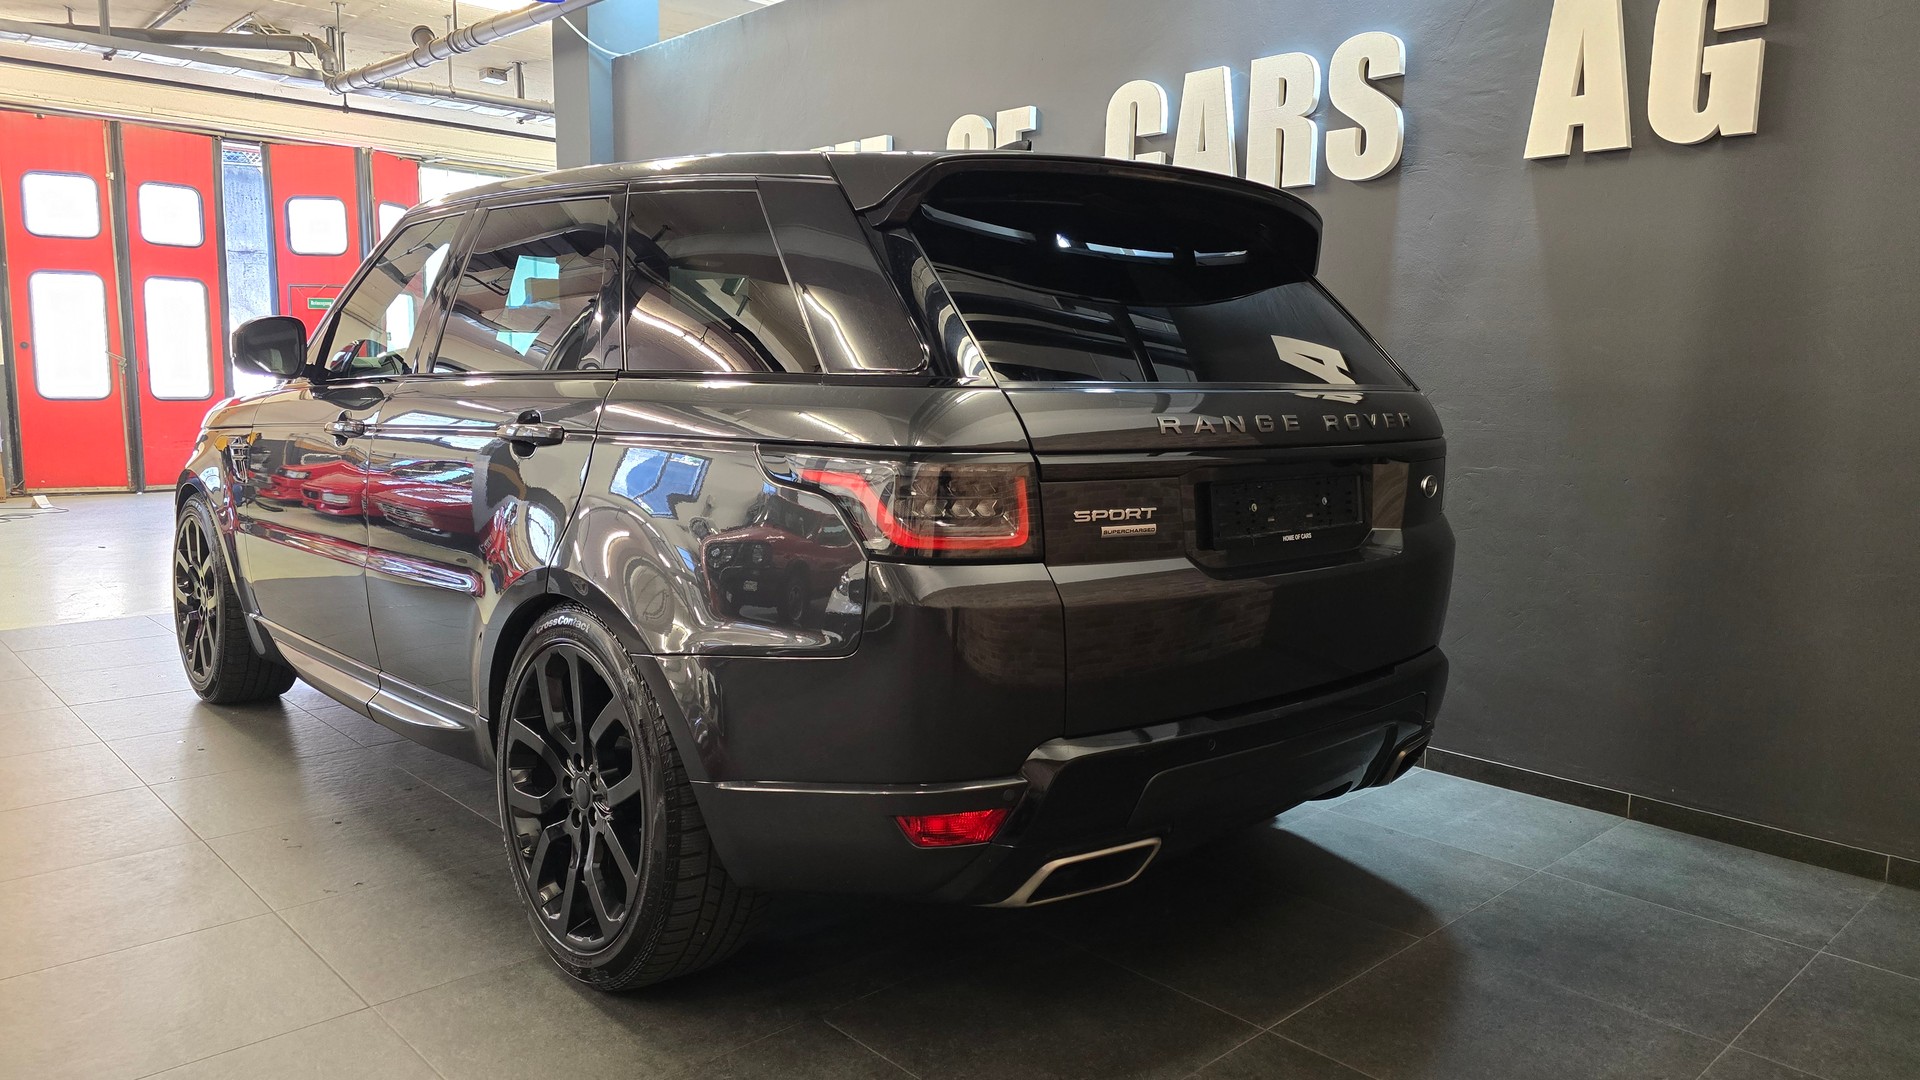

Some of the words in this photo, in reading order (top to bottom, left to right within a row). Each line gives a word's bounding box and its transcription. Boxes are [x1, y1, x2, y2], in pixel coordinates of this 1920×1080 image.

[1105, 31, 1406, 188] CARS
[1523, 0, 1769, 160] AG
[1157, 414, 1300, 435] RANGE
[1322, 412, 1411, 432] ROVER
[1073, 507, 1157, 523] SPORT
[1103, 527, 1156, 536] SUPERCHARGED
